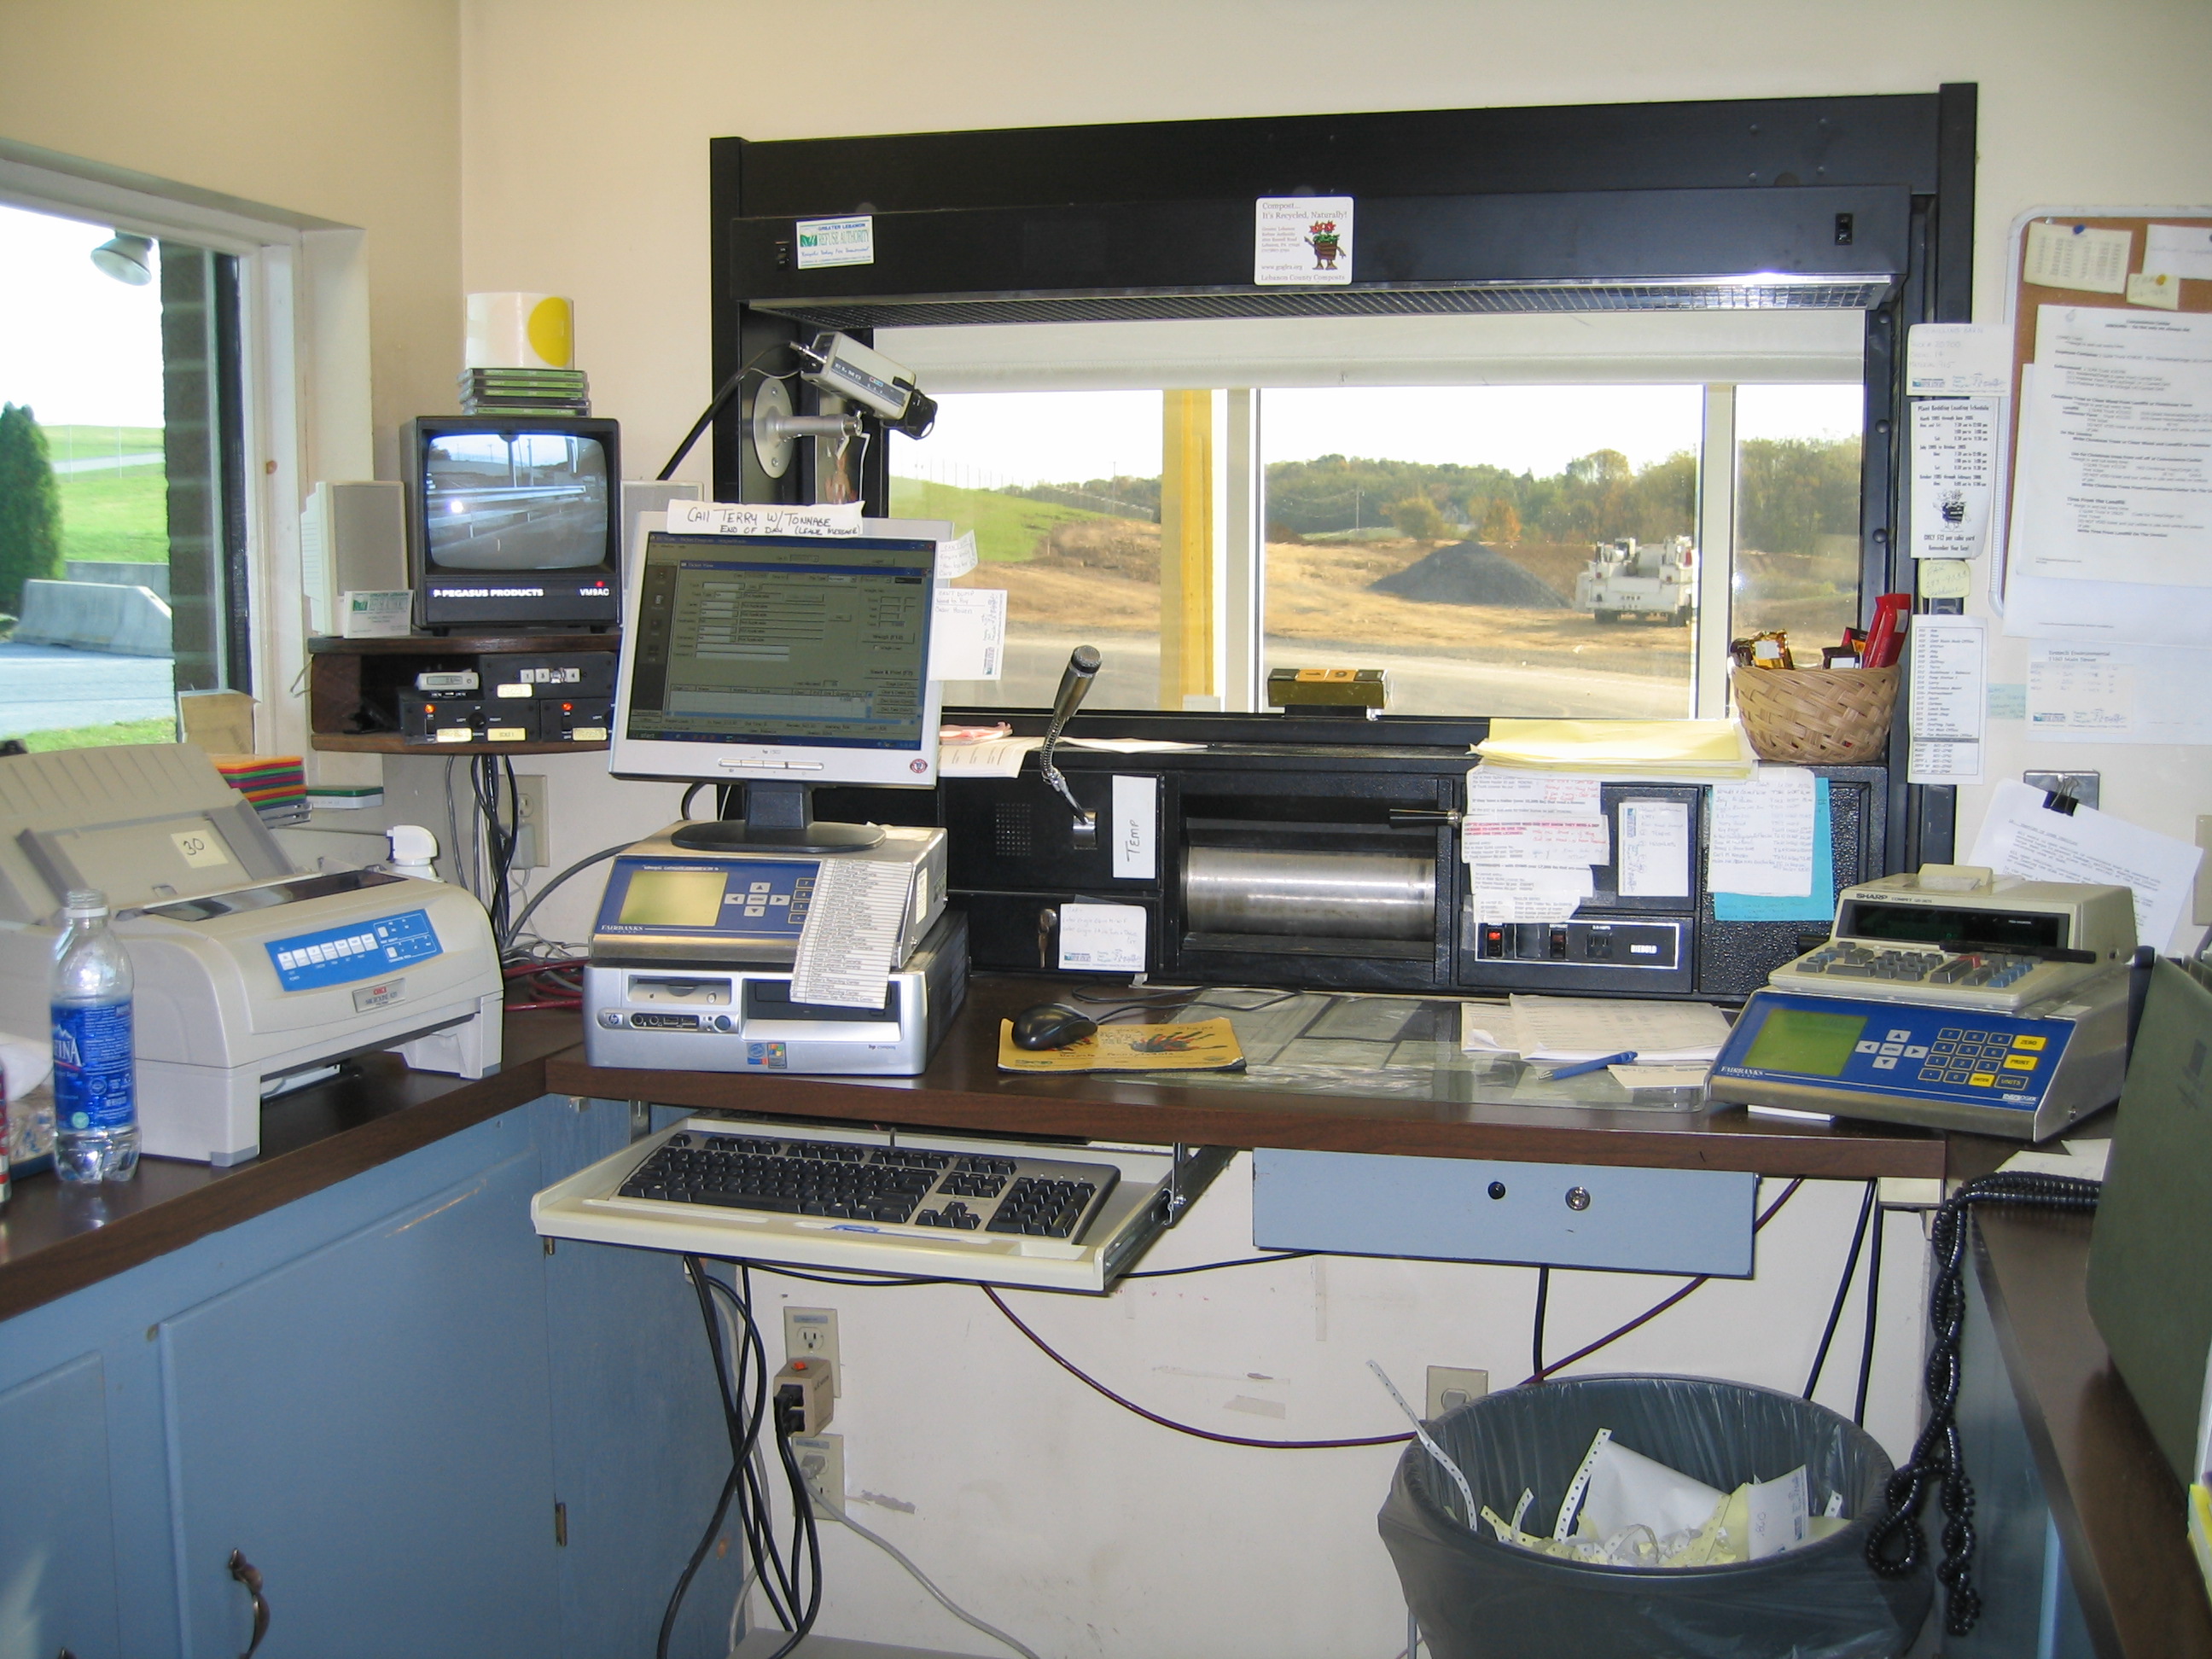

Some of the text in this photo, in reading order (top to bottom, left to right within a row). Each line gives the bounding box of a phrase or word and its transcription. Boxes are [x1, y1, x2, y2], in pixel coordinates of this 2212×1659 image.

[1275, 212, 1309, 220] Recycled,
[1311, 211, 1347, 219] Naturally!
[713, 509, 758, 526] TERRY
[720, 525, 737, 533] END
[744, 526, 756, 534] OF
[442, 589, 544, 597] PEGASUS PRODUCTS
[183, 838, 204, 855] 30
[1631, 945, 1657, 953] DIEBOLD
[1721, 1066, 1764, 1075] FAIRBANKS
